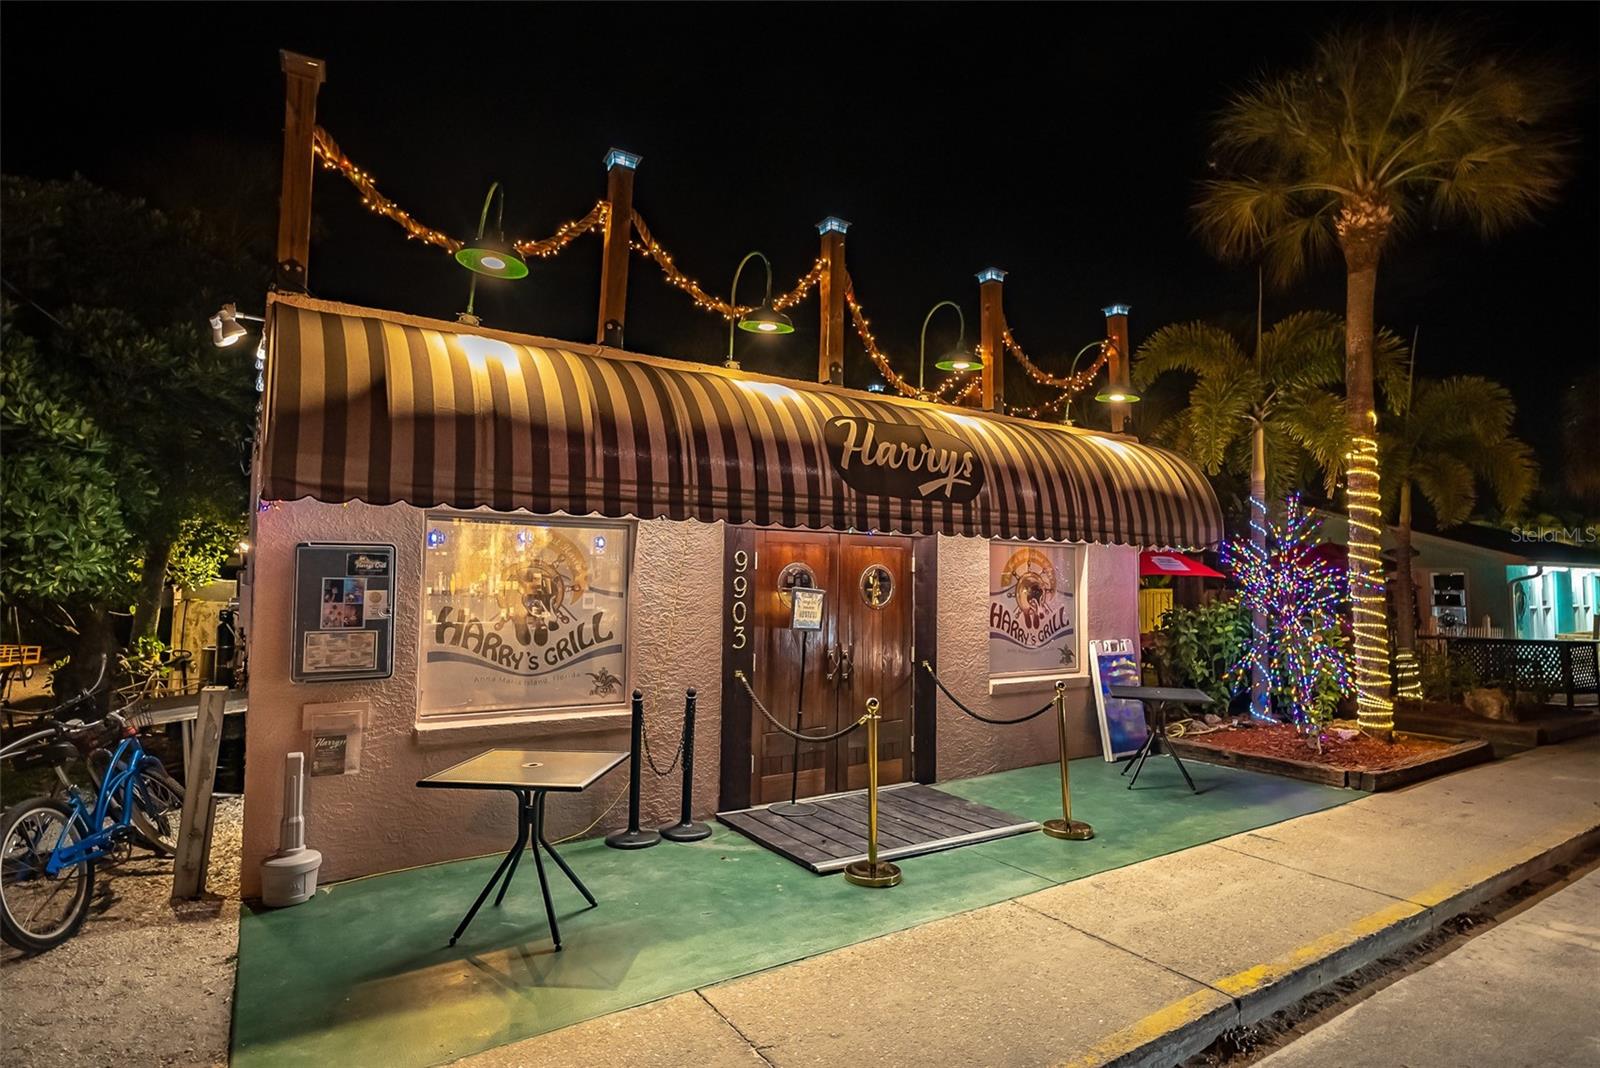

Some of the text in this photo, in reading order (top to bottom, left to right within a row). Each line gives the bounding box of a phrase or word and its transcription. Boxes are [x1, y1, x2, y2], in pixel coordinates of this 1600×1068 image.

[732, 550, 749, 649] 9903
[989, 602, 1070, 646] HARRY'S GRILL
[435, 606, 539, 670] HARRY'S
[544, 611, 614, 665] GRILL
